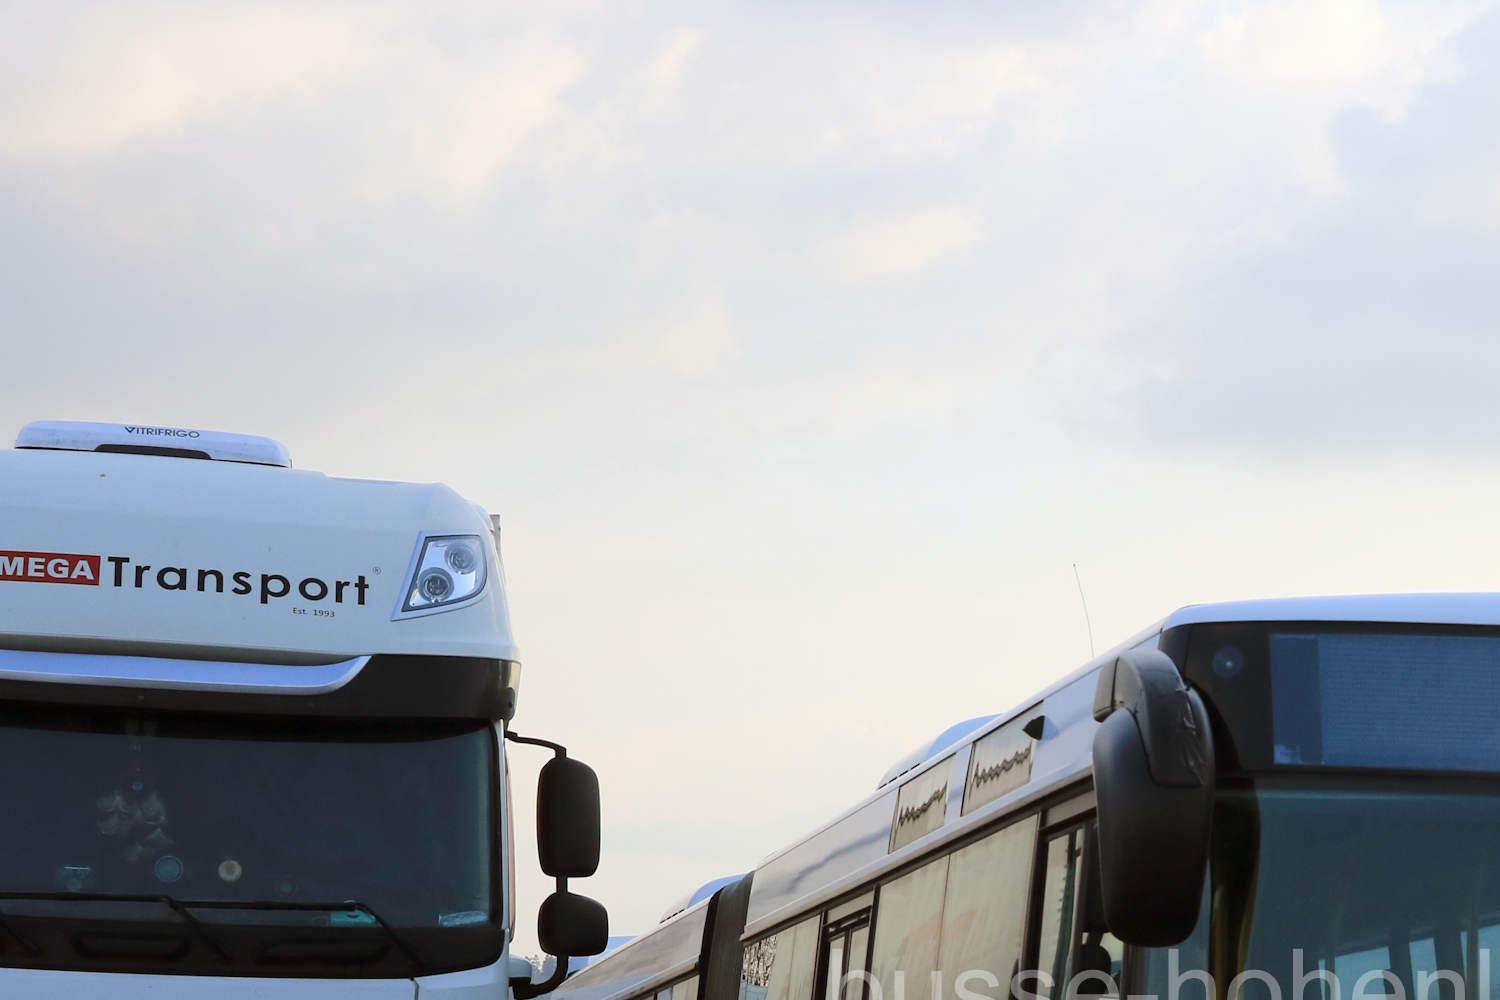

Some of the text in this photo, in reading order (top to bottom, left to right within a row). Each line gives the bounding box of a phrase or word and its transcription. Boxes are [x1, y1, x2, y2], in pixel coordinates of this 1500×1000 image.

[124, 426, 200, 438] VITRIFRIGO
[0, 554, 370, 605] MEGA Transport
[292, 607, 335, 618] Est. 1993
